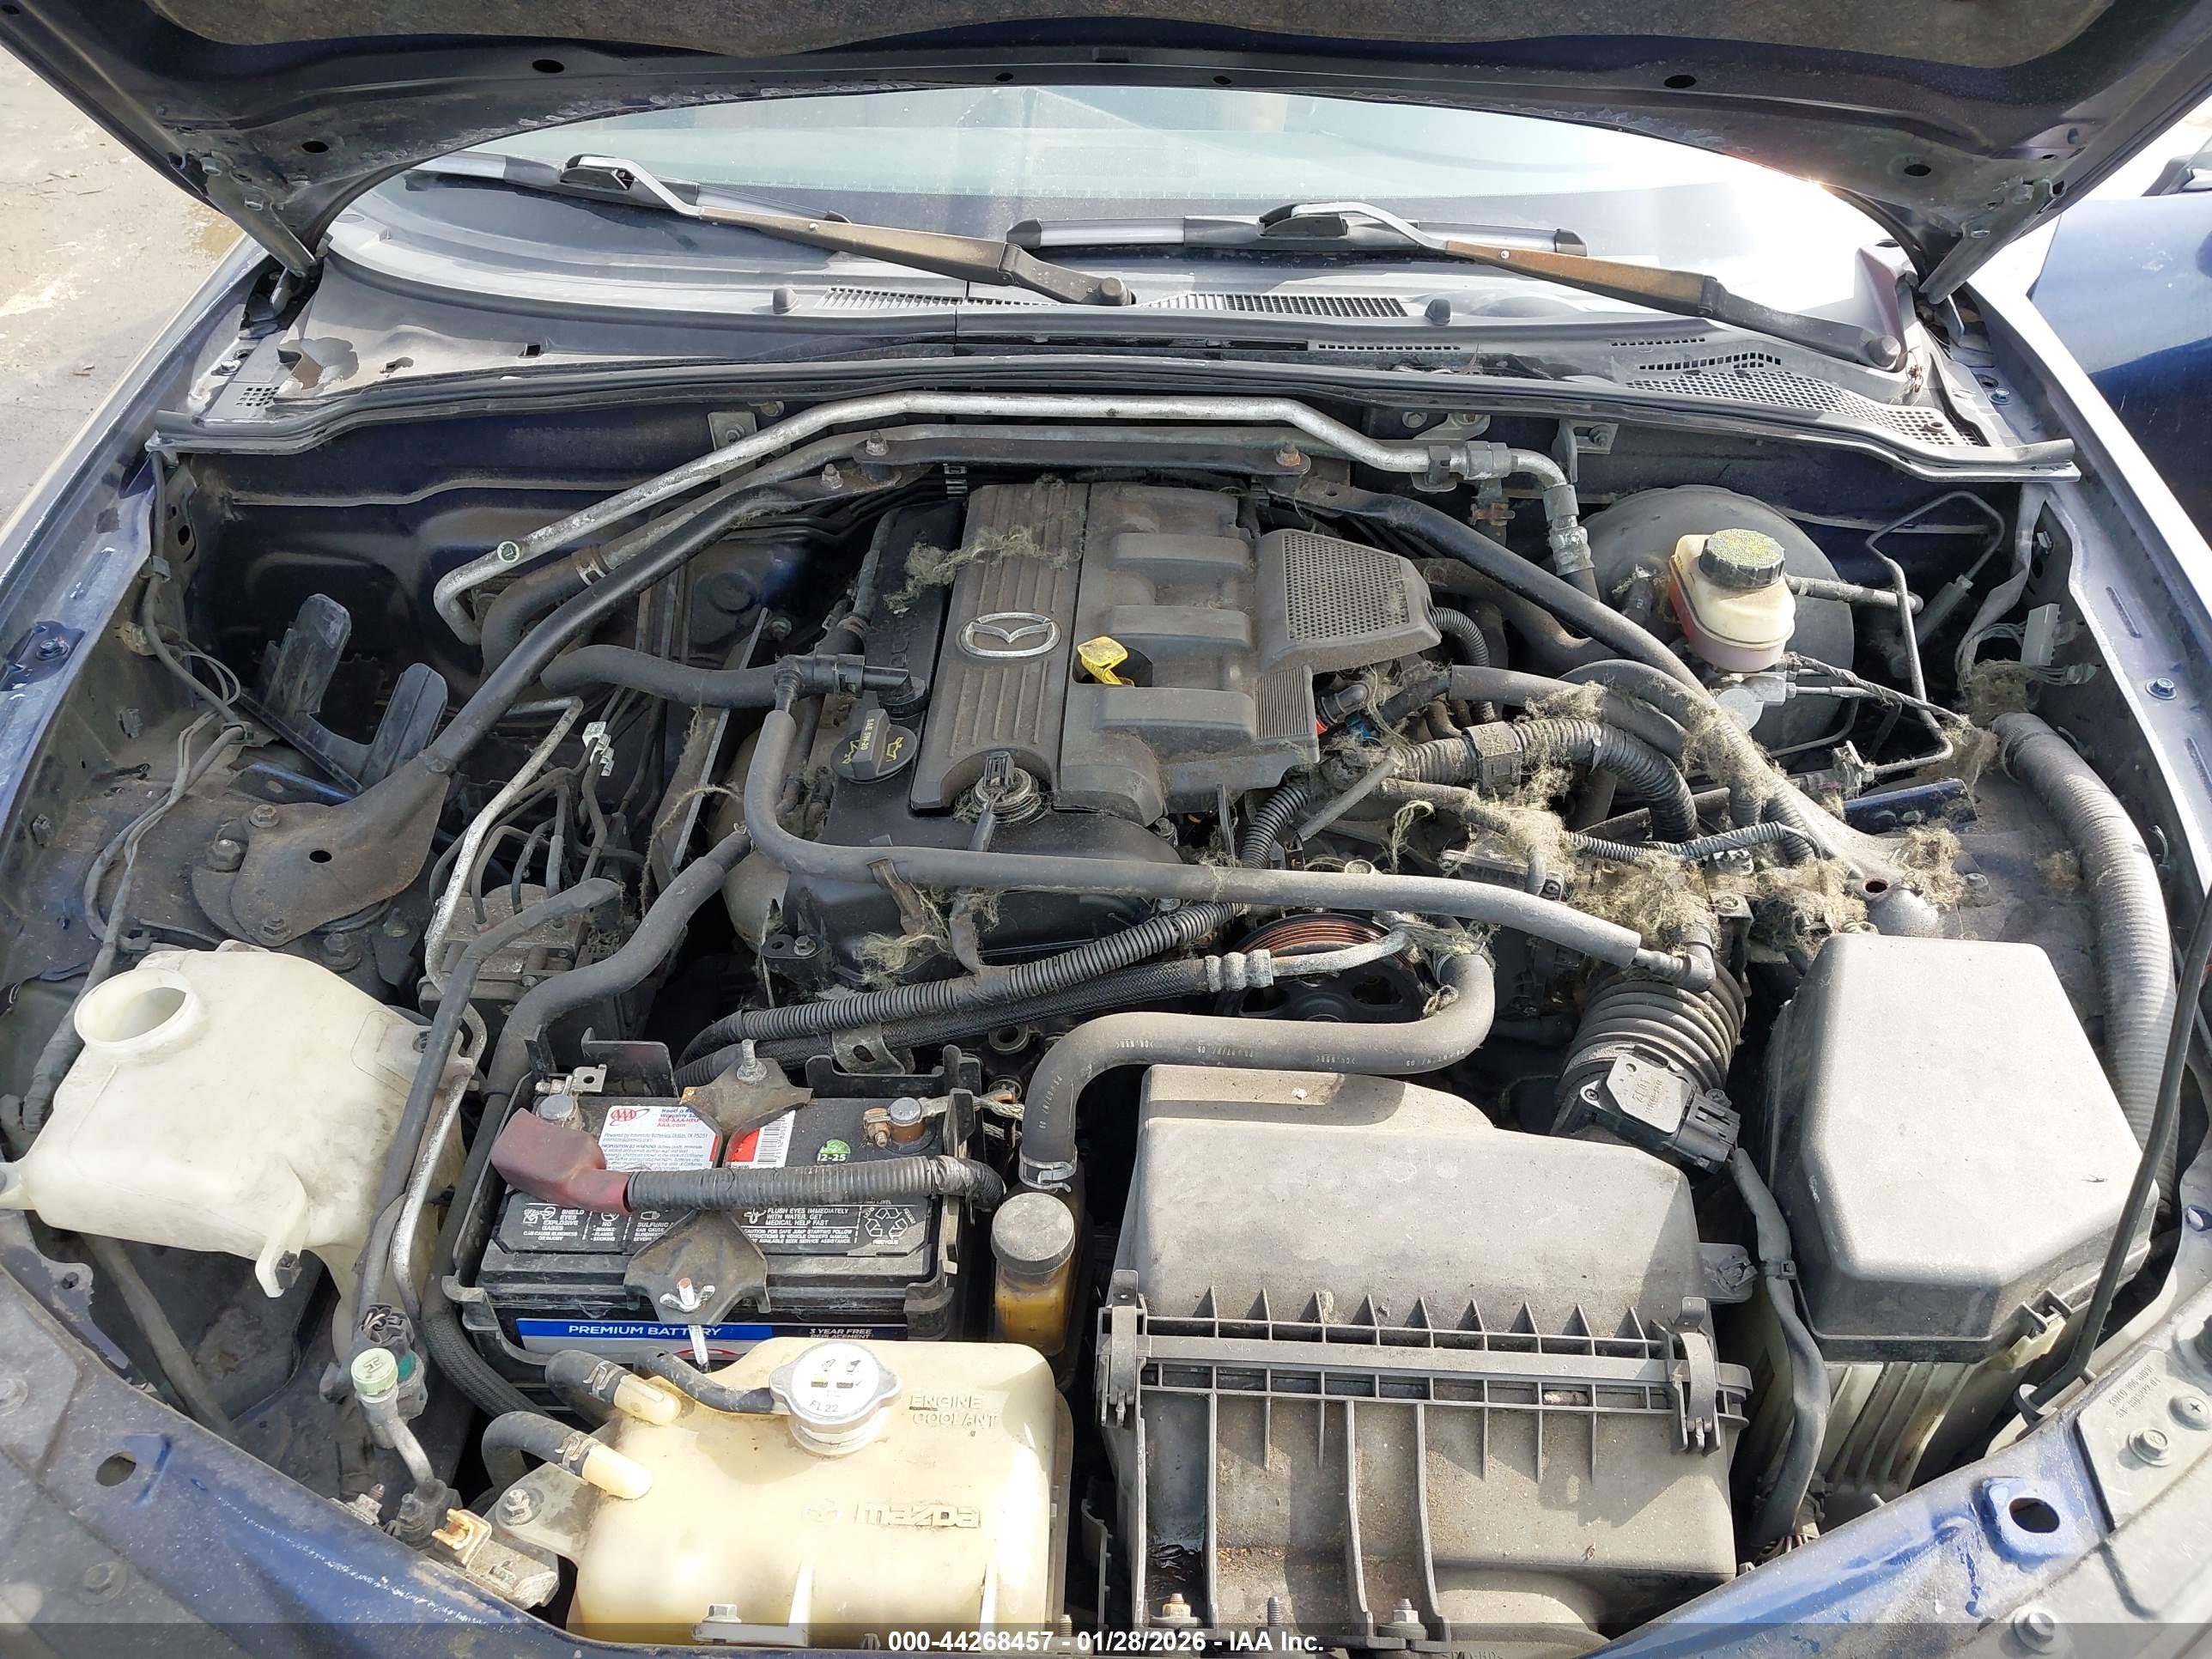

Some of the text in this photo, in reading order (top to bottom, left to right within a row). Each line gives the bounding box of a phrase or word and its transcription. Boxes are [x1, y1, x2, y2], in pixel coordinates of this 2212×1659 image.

[860, 718, 875, 750] SAE 5W-20
[817, 1153, 846, 1162] 12-25
[568, 1325, 722, 1336] PREMIUM BATTRY
[909, 1395, 982, 1410] ENGINE
[913, 1413, 997, 1427] COOLANT
